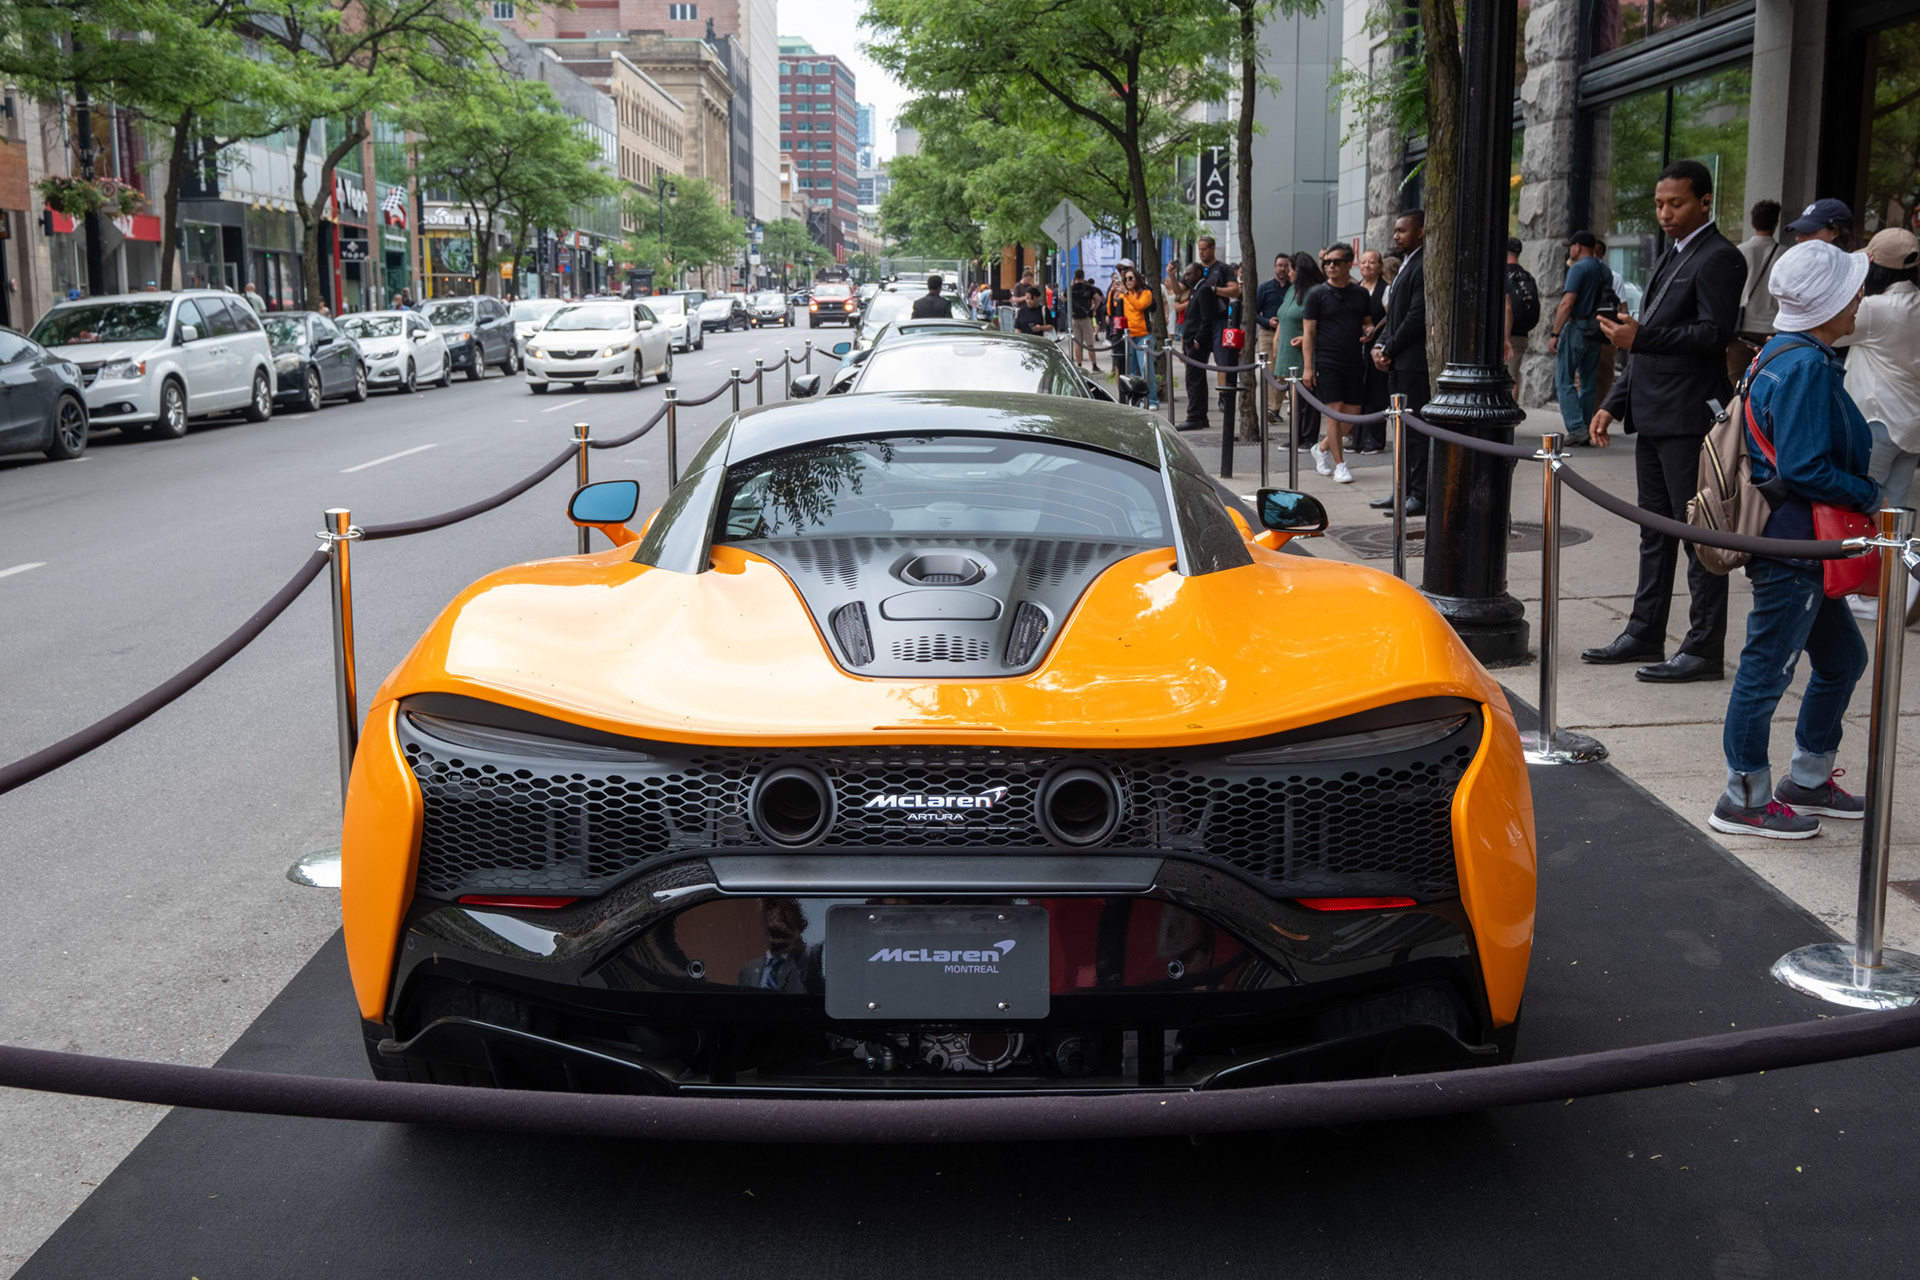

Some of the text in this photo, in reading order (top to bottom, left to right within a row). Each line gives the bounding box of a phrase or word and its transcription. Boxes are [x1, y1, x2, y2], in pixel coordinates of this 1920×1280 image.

[1205, 145, 1225, 209] TAG
[341, 250, 365, 259] Vape
[864, 793, 993, 808] McLaren
[907, 813, 965, 821] ARTURA
[868, 948, 1000, 962] McLaren
[944, 965, 999, 974] MONTREAL
